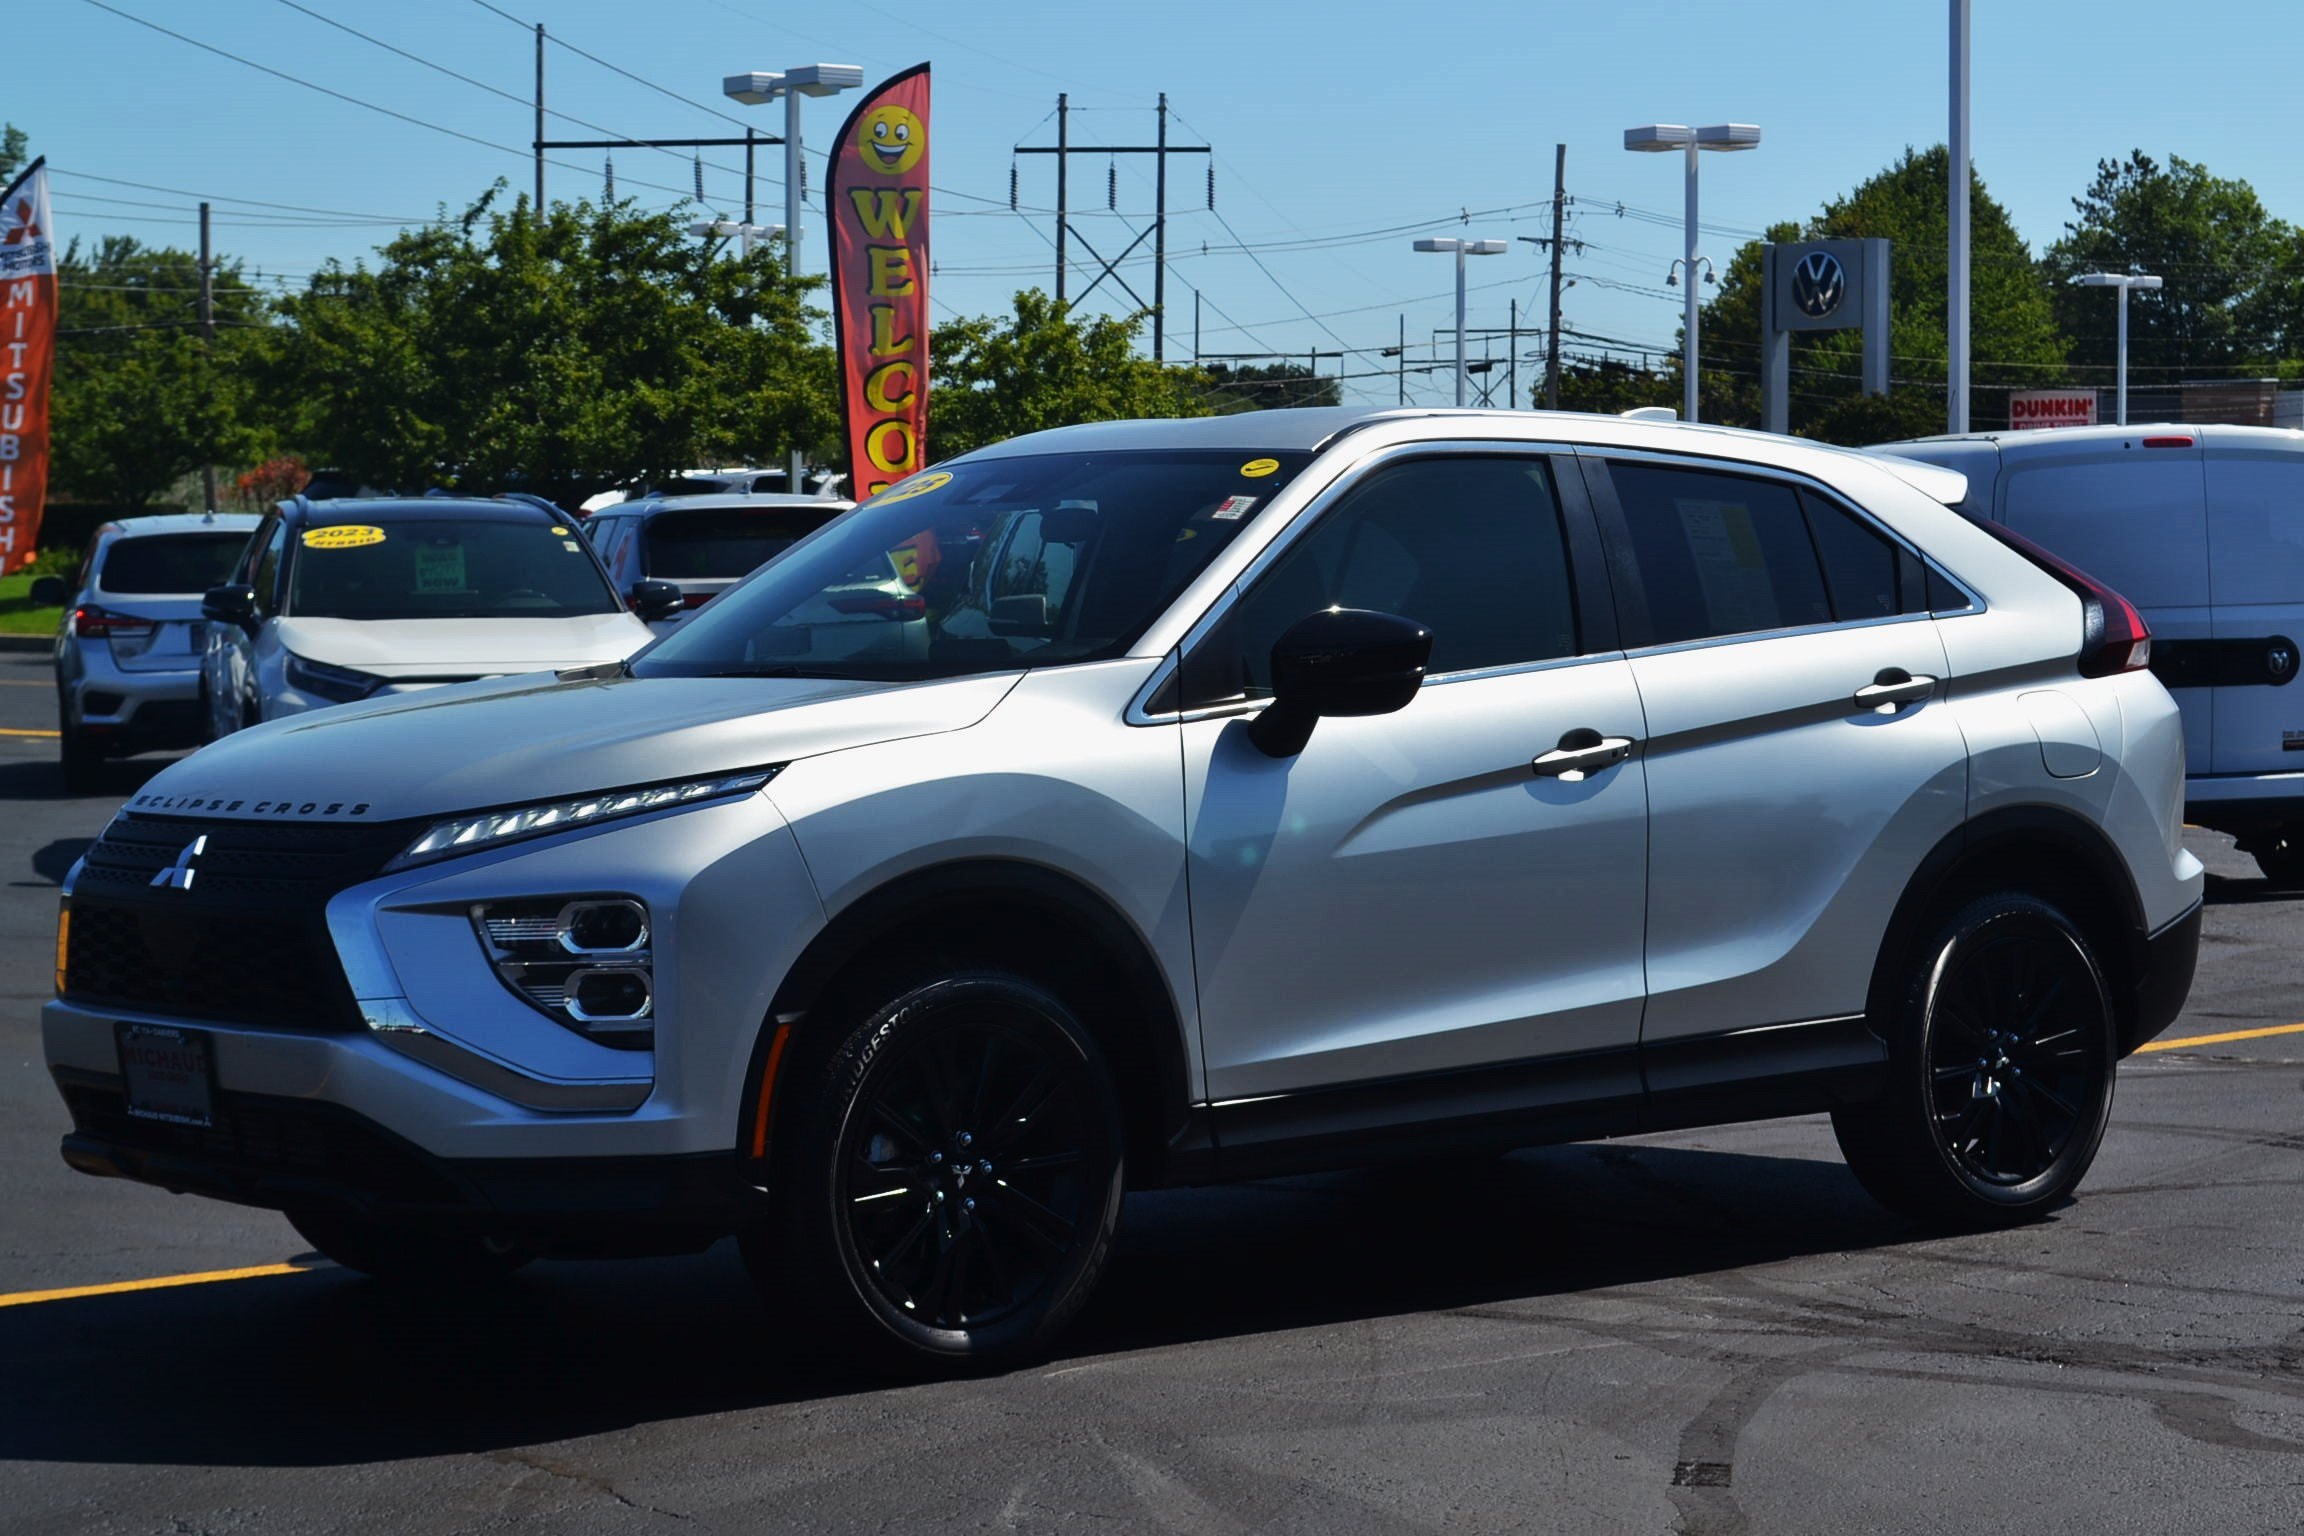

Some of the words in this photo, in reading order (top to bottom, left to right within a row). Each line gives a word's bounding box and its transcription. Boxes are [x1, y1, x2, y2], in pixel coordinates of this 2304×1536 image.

[2012, 397, 2094, 418] DUNKIN'
[134, 795, 245, 812] ECLIPSE
[253, 800, 372, 817] CROSS
